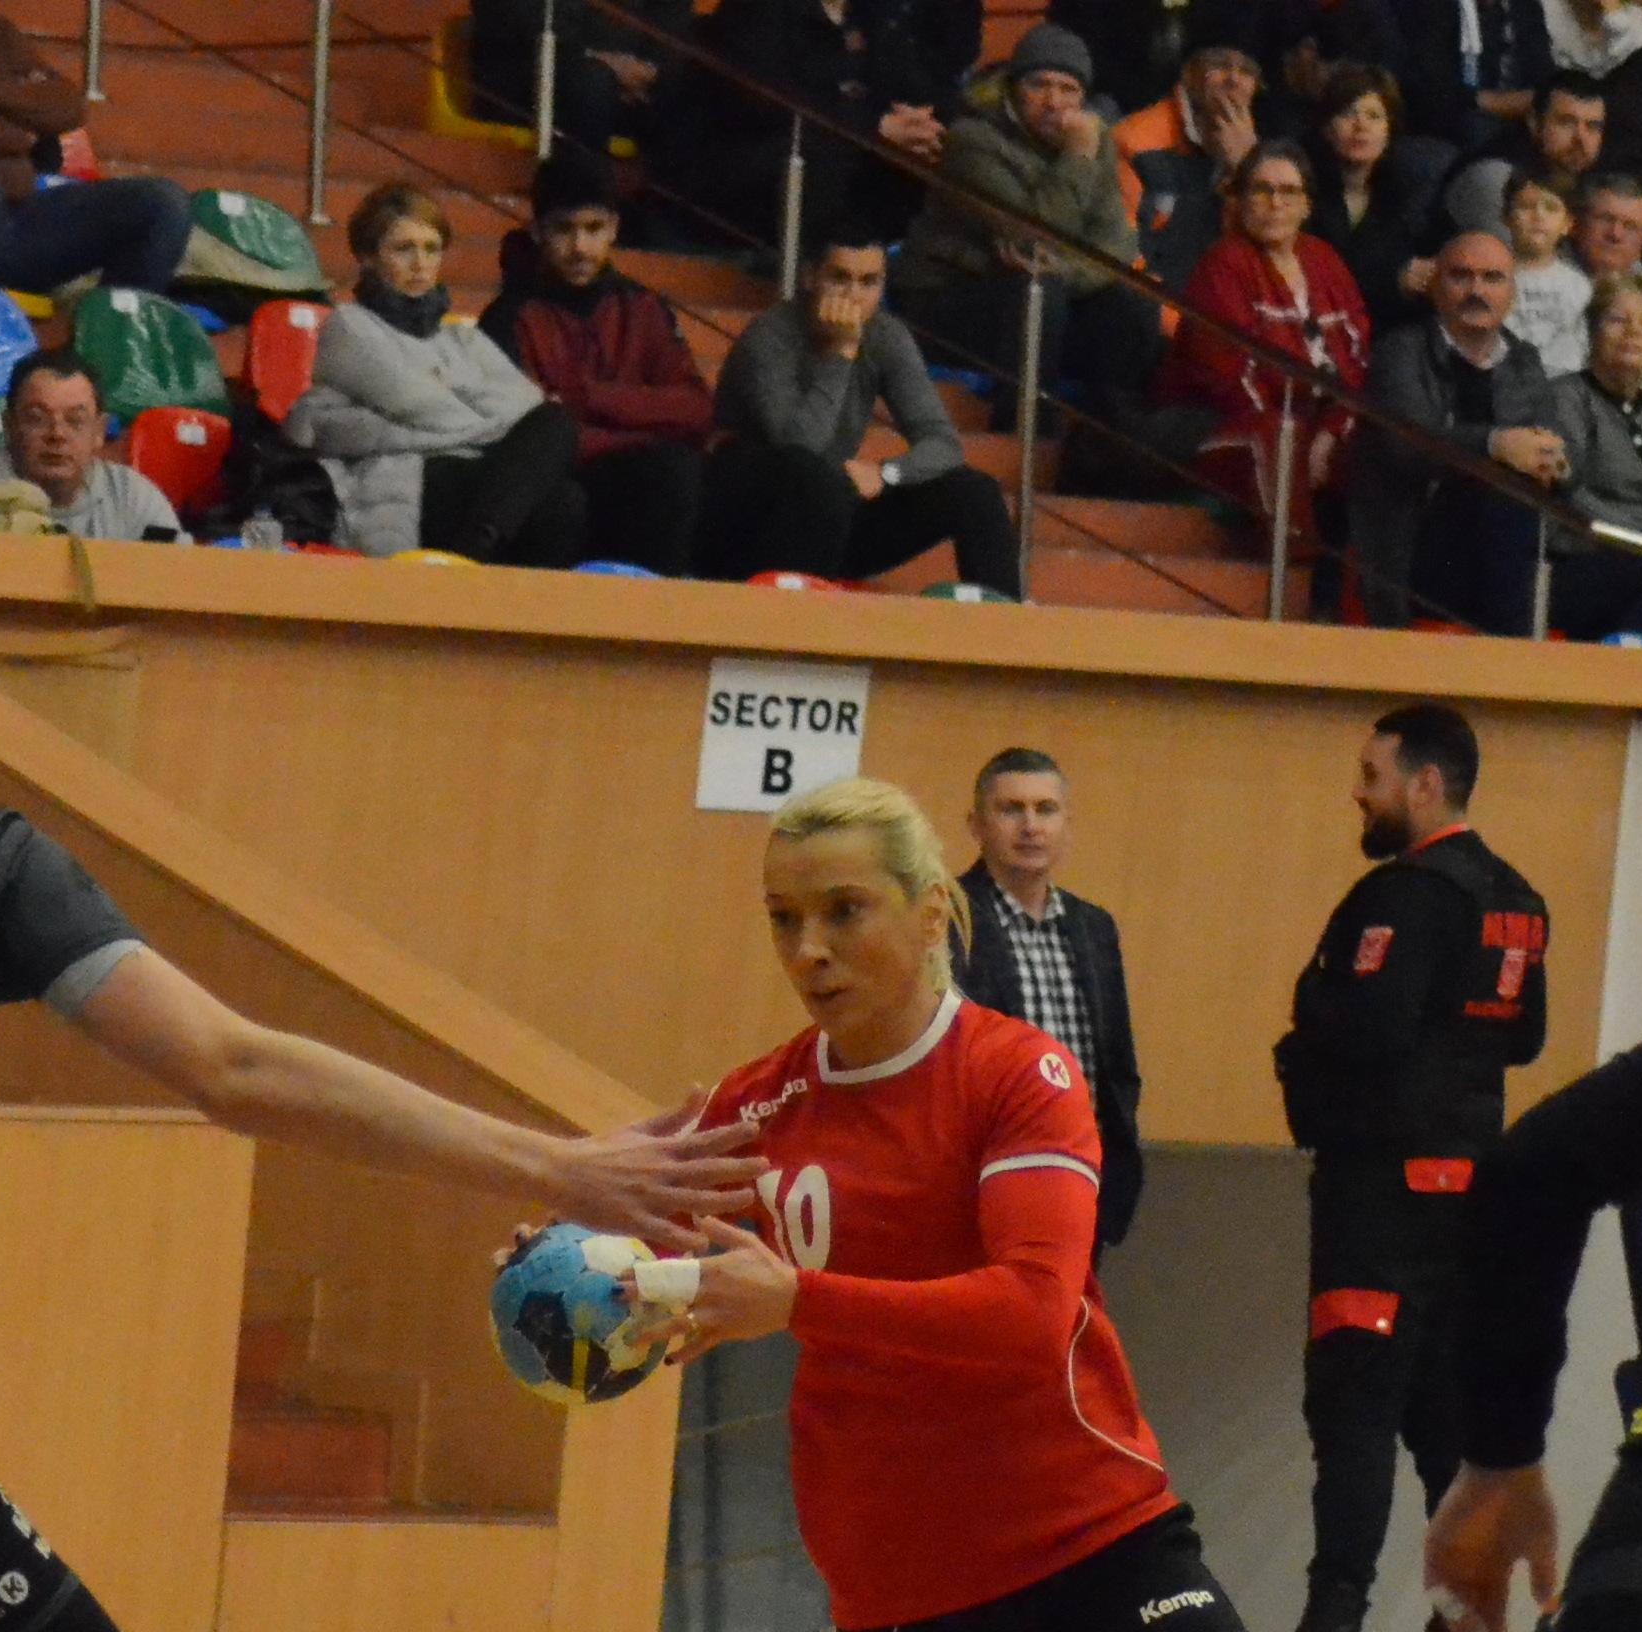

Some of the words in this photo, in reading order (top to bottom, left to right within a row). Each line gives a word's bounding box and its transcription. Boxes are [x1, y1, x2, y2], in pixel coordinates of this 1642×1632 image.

[709, 691, 859, 735] SECTOR
[762, 748, 794, 794] B
[1138, 1590, 1215, 1624] Kempa
